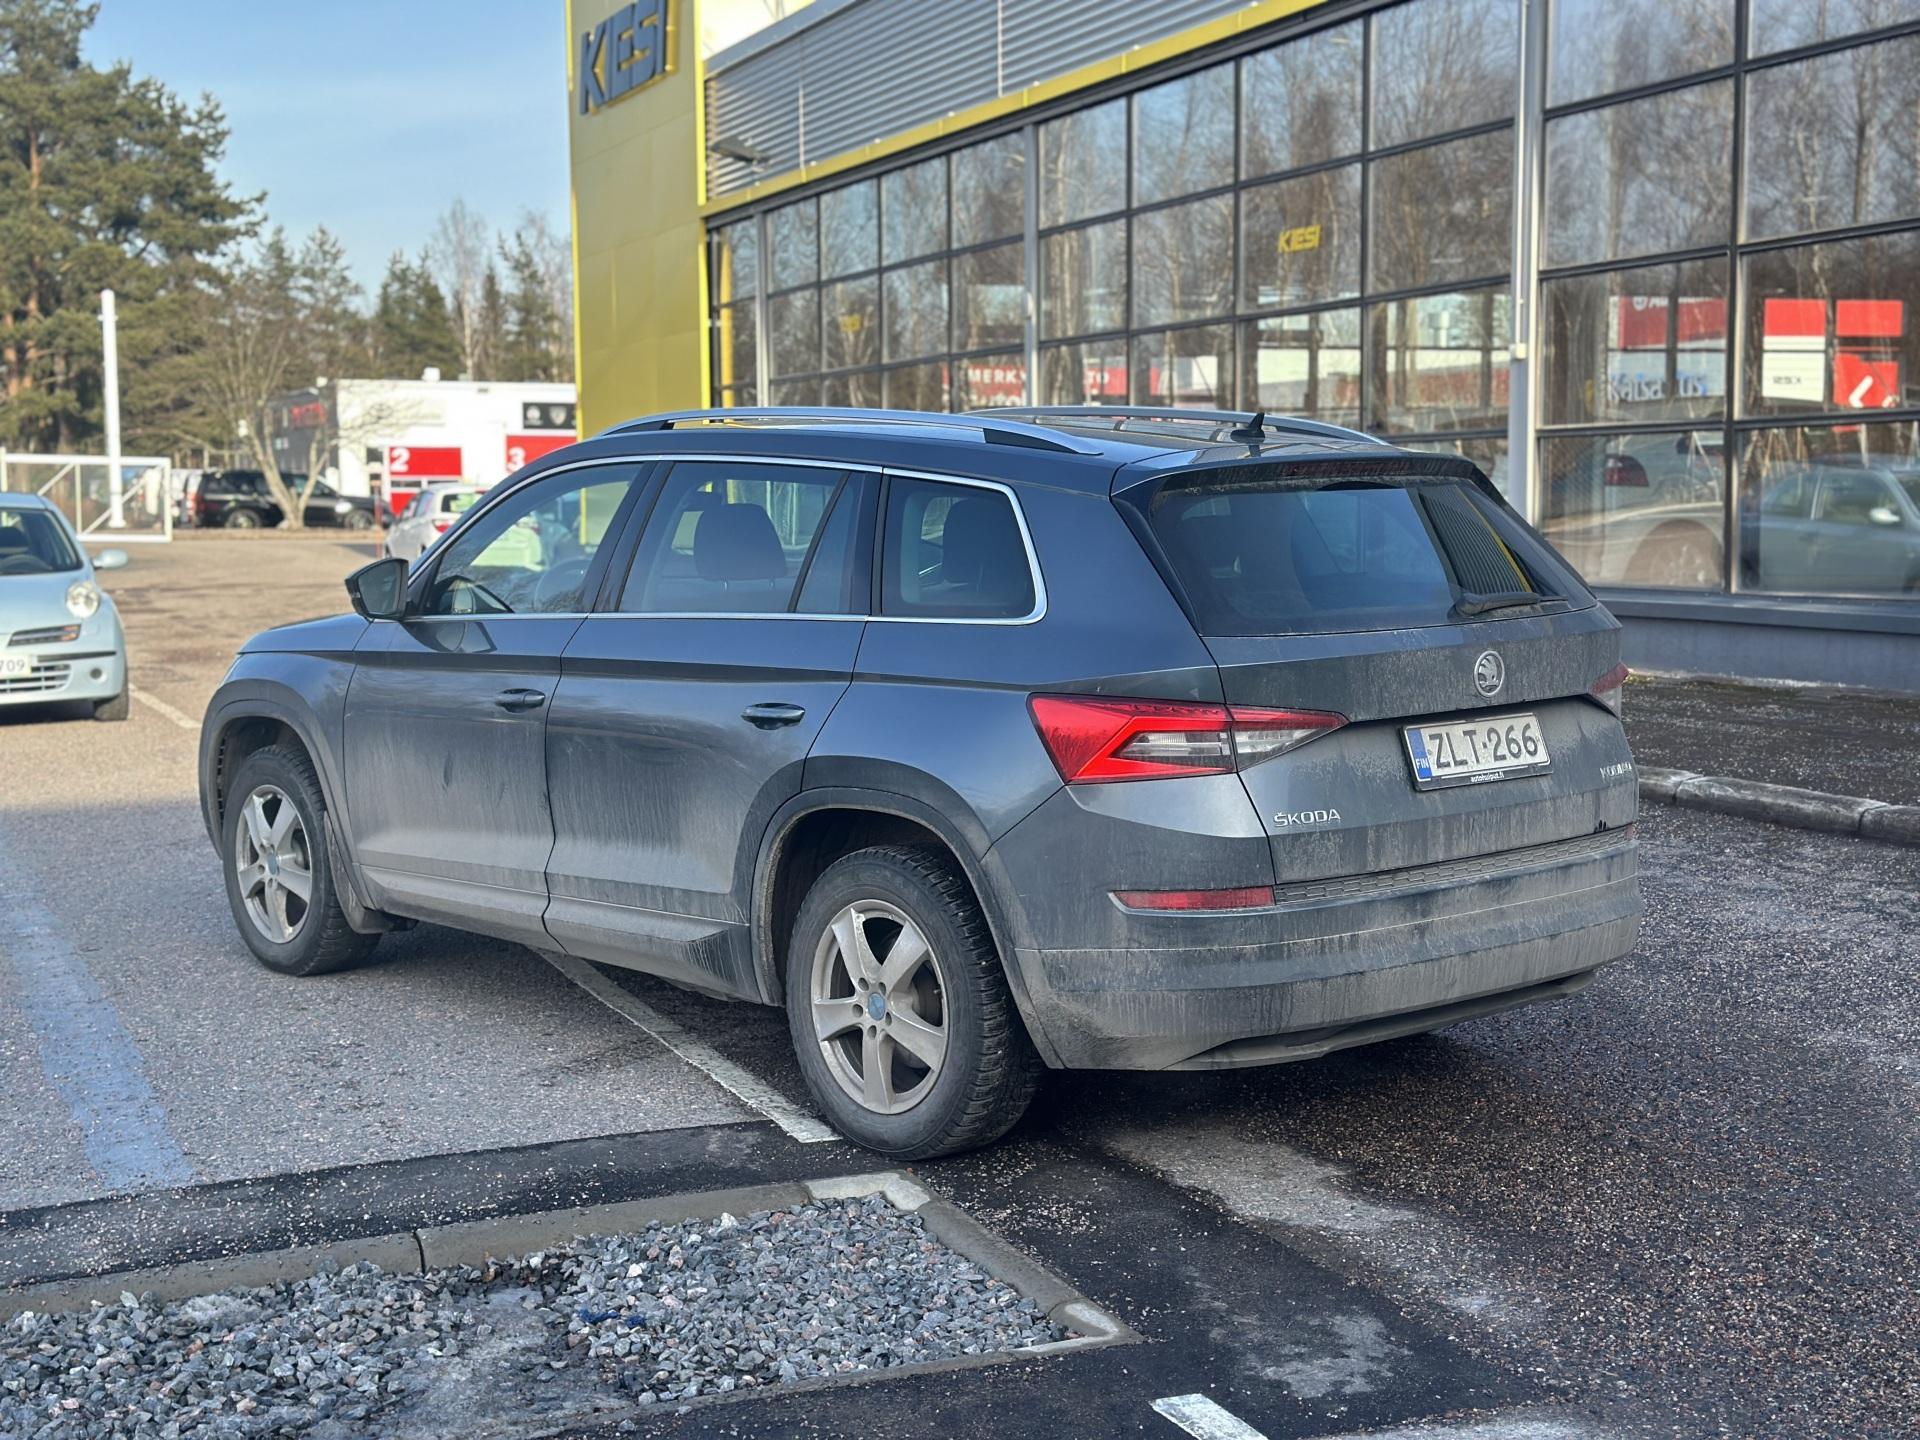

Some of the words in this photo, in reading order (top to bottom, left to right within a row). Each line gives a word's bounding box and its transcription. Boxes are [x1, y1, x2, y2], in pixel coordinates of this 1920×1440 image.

[580, 0, 668, 115] KIESI
[1279, 224, 1321, 253] KIESI
[391, 448, 411, 473] 2
[506, 446, 527, 475] 3
[1428, 722, 1538, 769] ZLT-266
[1415, 757, 1431, 770] FIN
[1273, 808, 1341, 828] ŠKODA
